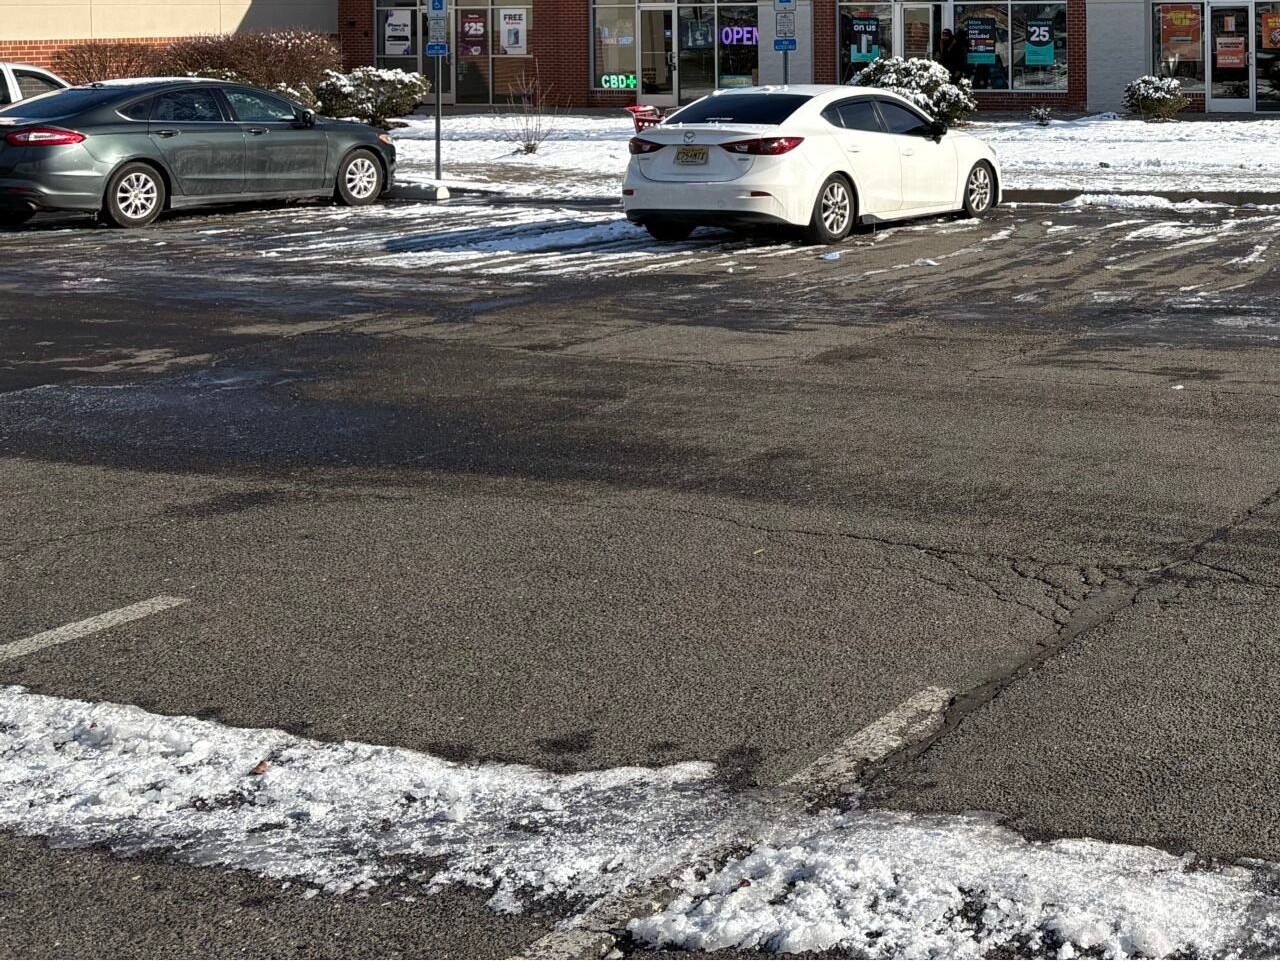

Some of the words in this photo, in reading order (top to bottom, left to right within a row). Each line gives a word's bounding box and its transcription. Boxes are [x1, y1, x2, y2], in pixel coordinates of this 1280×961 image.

[503, 13, 523, 21] FREE
[464, 22, 484, 35] $25
[721, 26, 759, 45] OPEN
